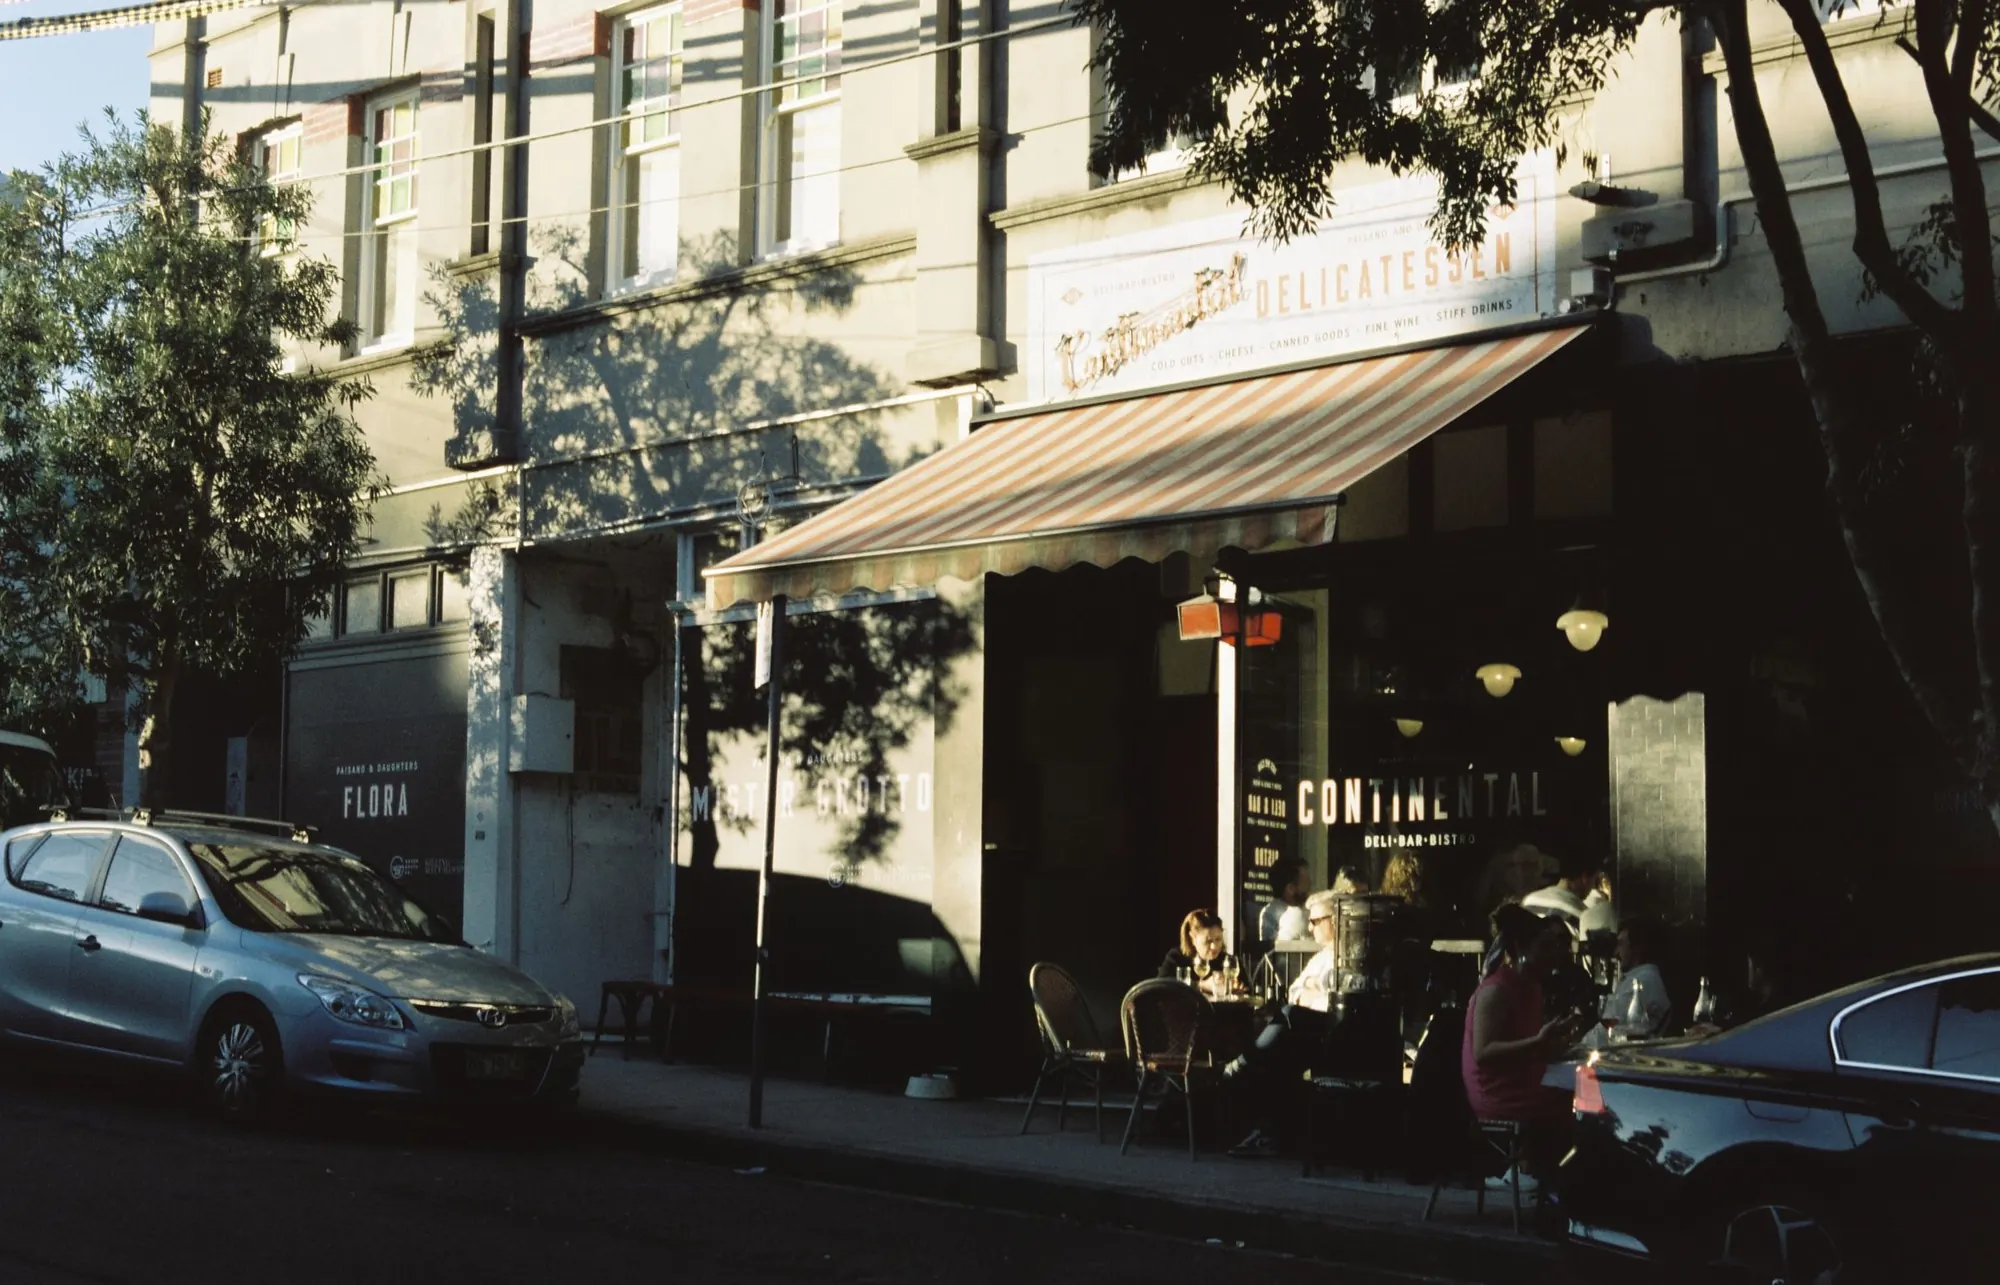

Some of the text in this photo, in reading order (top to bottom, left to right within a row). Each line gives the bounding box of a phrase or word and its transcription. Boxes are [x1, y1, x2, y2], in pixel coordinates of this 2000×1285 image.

[1392, 222, 1413, 238] AND
[1256, 231, 1511, 318] DELICATESSEN
[1151, 299, 1513, 371] COLD CUTS CHEESE CANNED GOODS FINE WINE STIFF DRINKS
[376, 760, 418, 773] DAUGHTERS
[343, 783, 408, 819] FLORA
[692, 771, 932, 822] MISTR GROTTO
[1298, 771, 1547, 825] CONTINENTAL
